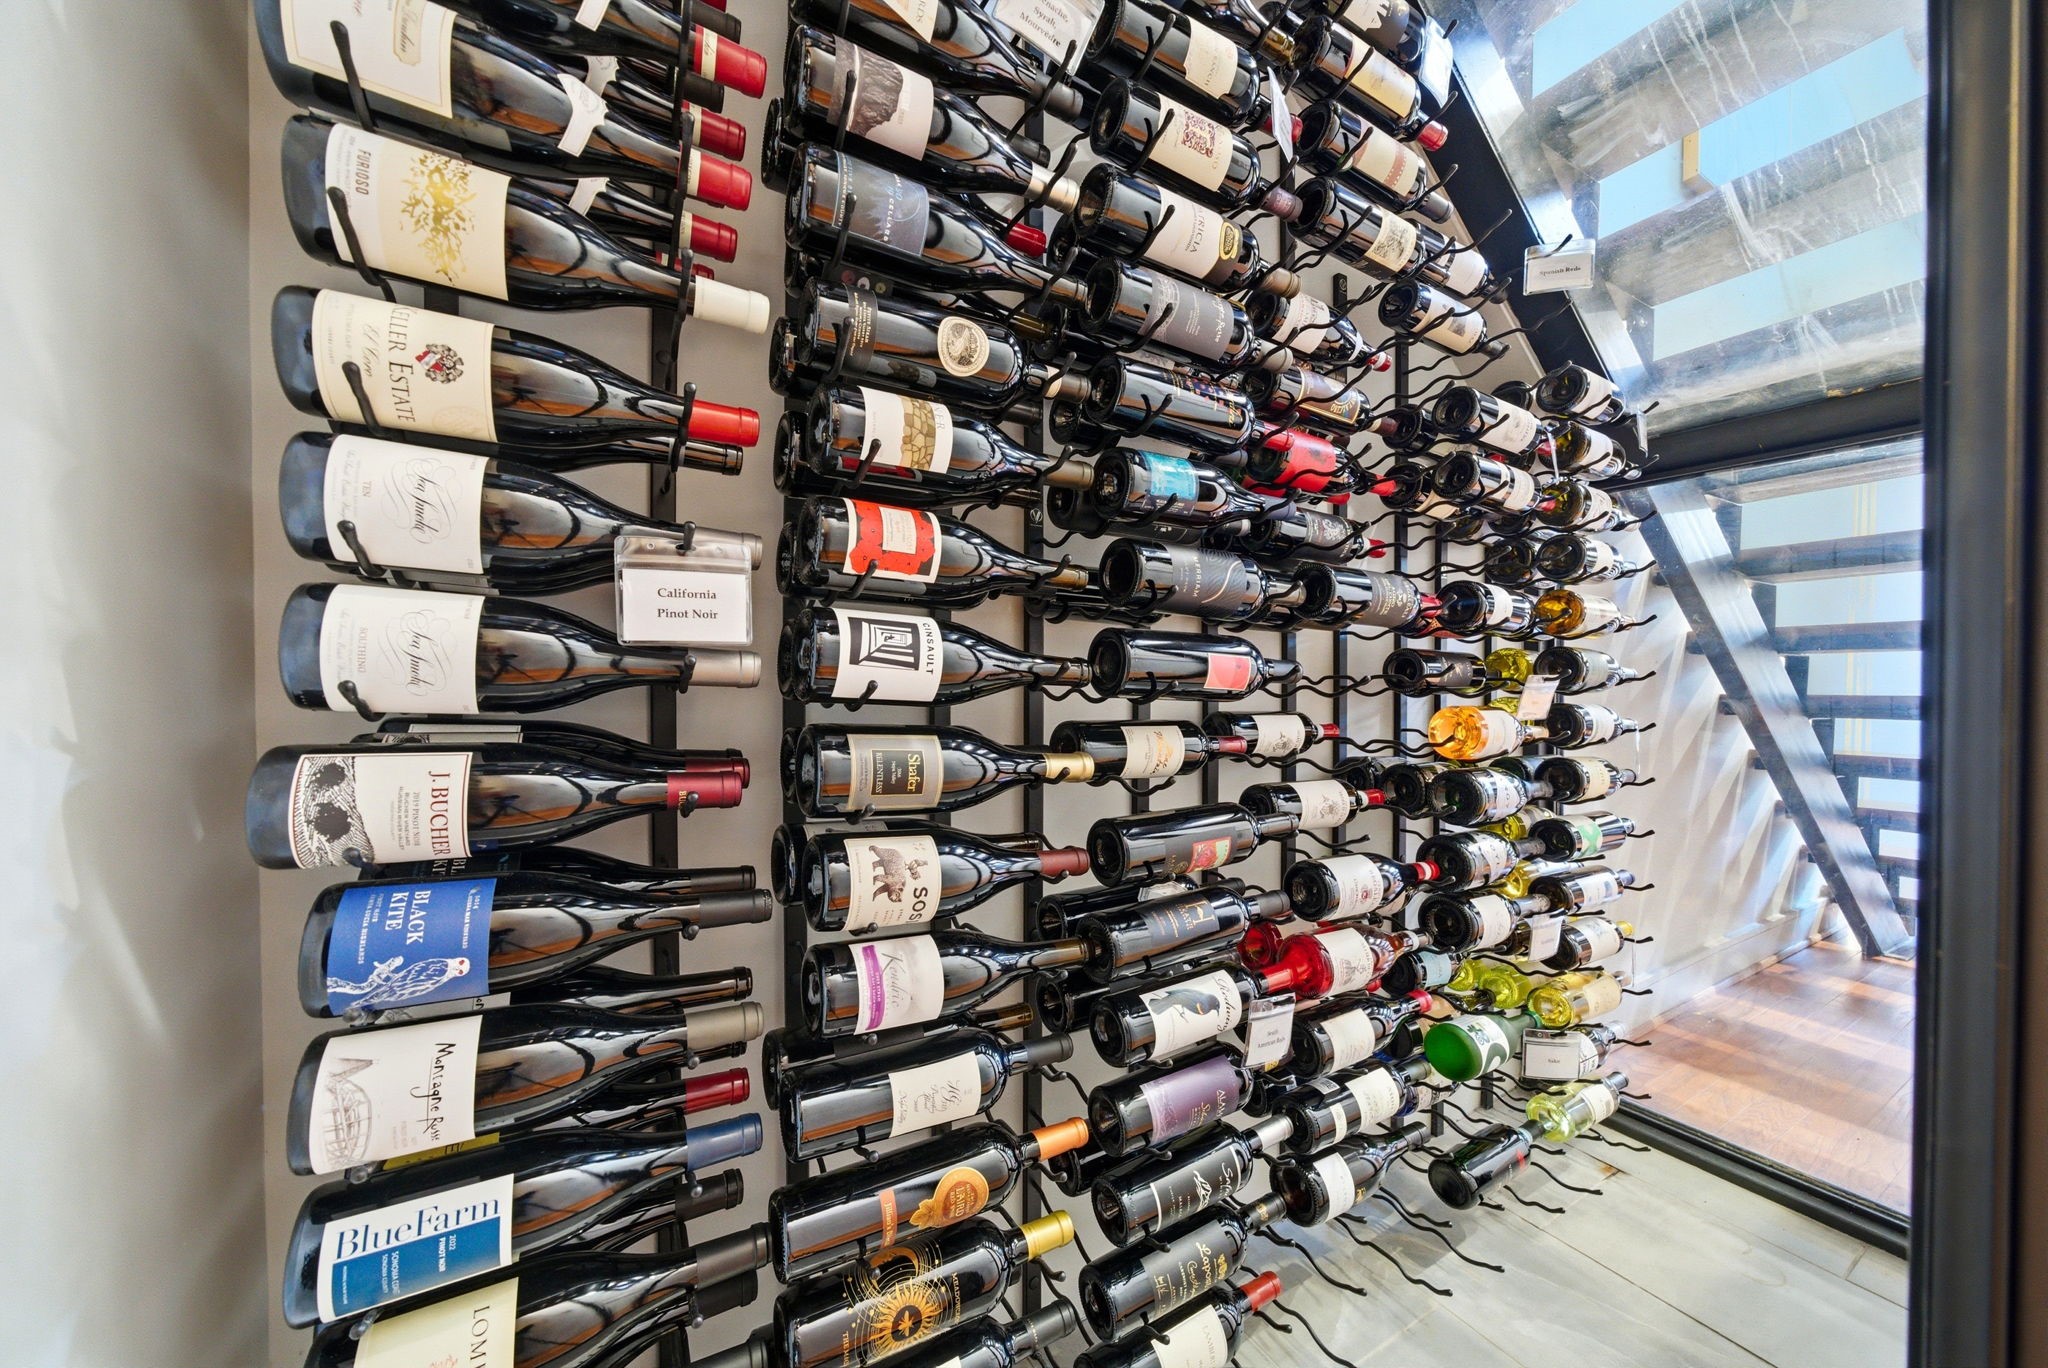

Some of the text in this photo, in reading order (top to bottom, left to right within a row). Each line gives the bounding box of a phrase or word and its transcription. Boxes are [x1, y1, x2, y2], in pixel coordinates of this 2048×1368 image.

[355, 150, 373, 196] FURIOSO
[1565, 266, 1582, 274] Reds
[387, 305, 418, 423] KELLER ESTATE
[657, 587, 717, 600] California
[1193, 556, 1202, 598] MERRIAM
[657, 608, 718, 620] Pinot Noir
[923, 622, 936, 676] CINSAULT
[874, 752, 885, 793] RELENTLESS
[907, 752, 923, 793] Shafer
[428, 770, 452, 857] J. BUCHER
[385, 891, 409, 931] KITE
[406, 890, 432, 945] BLACK
[908, 886, 929, 921] SOS
[409, 1043, 457, 1113] Montagne
[336, 1199, 501, 1260] BlueFarm
[391, 1251, 400, 1280] SONOMA
